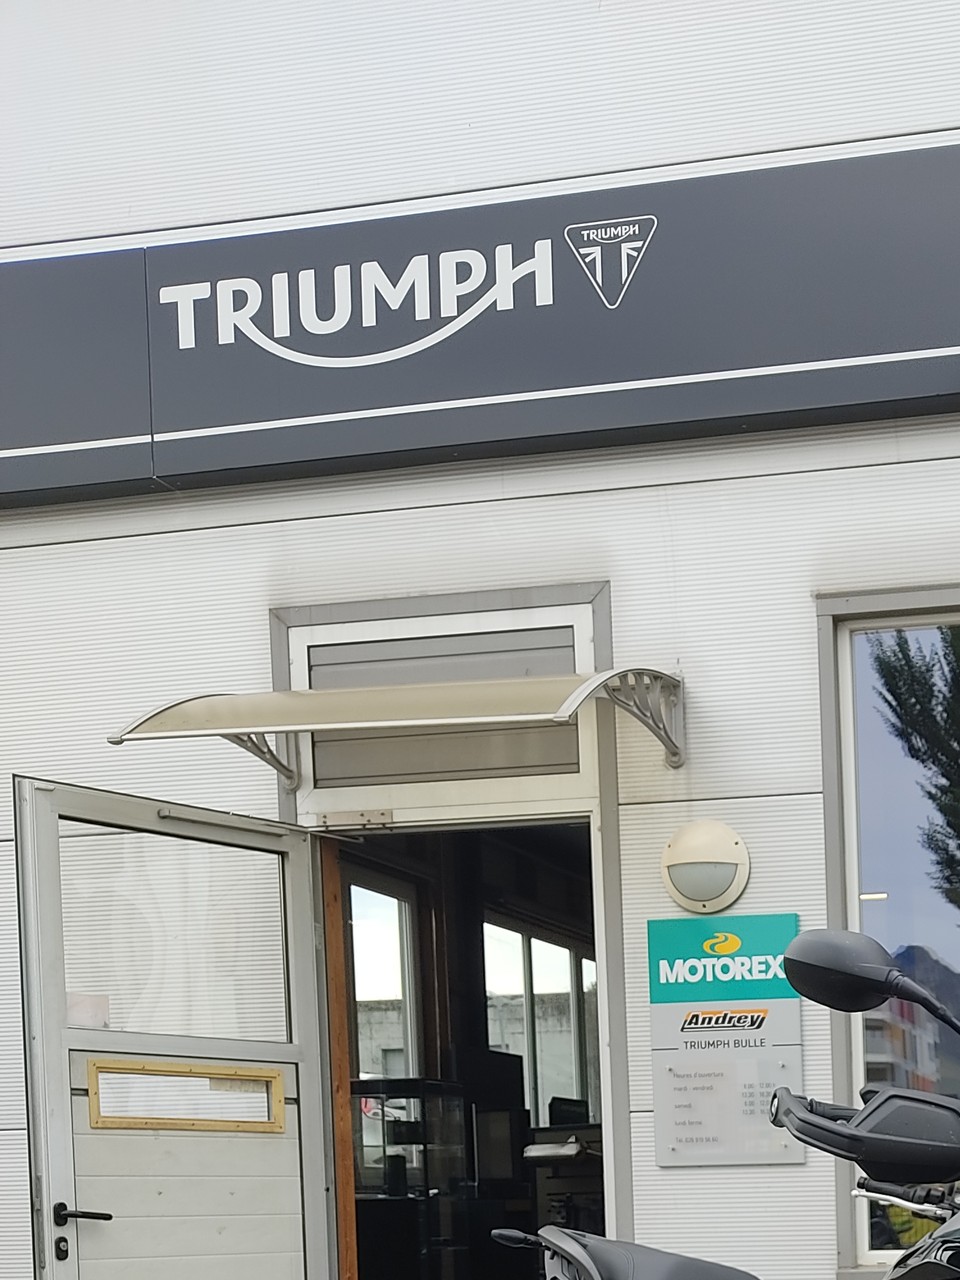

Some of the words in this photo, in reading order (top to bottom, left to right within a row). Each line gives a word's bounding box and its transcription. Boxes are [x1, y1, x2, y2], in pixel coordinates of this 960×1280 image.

[580, 223, 640, 244] TRIUMPH
[159, 238, 555, 368] TRIUMPH
[658, 954, 786, 984] MOTOREX
[686, 1012, 762, 1031] Andrey
[683, 1039, 730, 1051] TRIUMPH
[733, 1037, 766, 1049] BULLE
